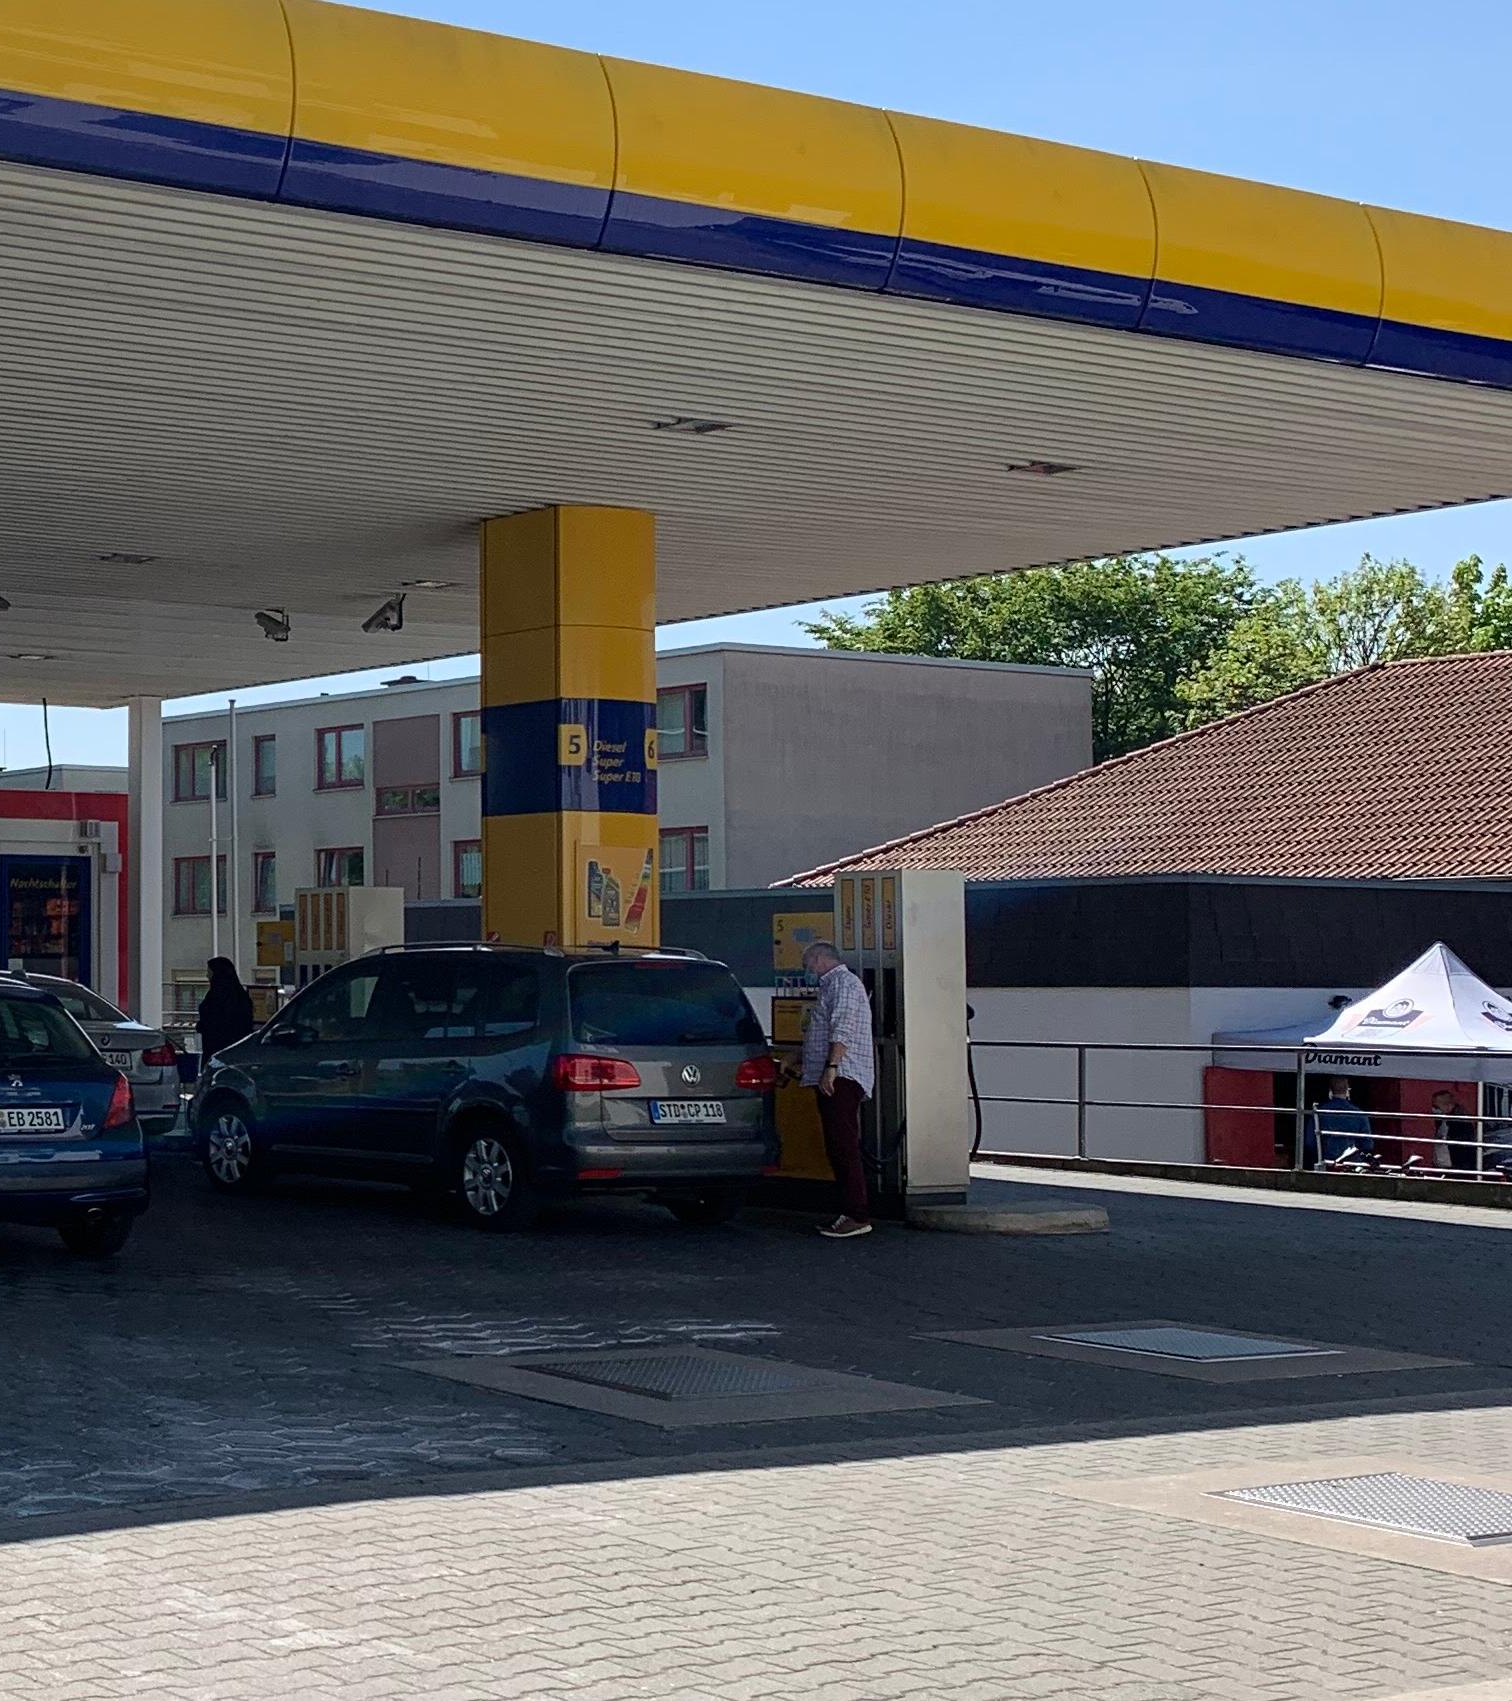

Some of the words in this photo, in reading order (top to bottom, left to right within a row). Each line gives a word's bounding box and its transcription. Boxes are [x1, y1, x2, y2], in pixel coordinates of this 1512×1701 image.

[568, 735, 581, 754] 5
[593, 740, 627, 753] Diesel
[647, 740, 656, 760] 6
[592, 756, 624, 770] Super
[592, 771, 625, 785] Super
[776, 920, 785, 932] 5
[1361, 1016, 1411, 1027] Diamant
[1303, 1043, 1383, 1067] Diamant
[659, 1104, 681, 1118] STD
[687, 1103, 701, 1117] CP
[8, 1111, 26, 1128] EB
[29, 1111, 63, 1127] 2581
